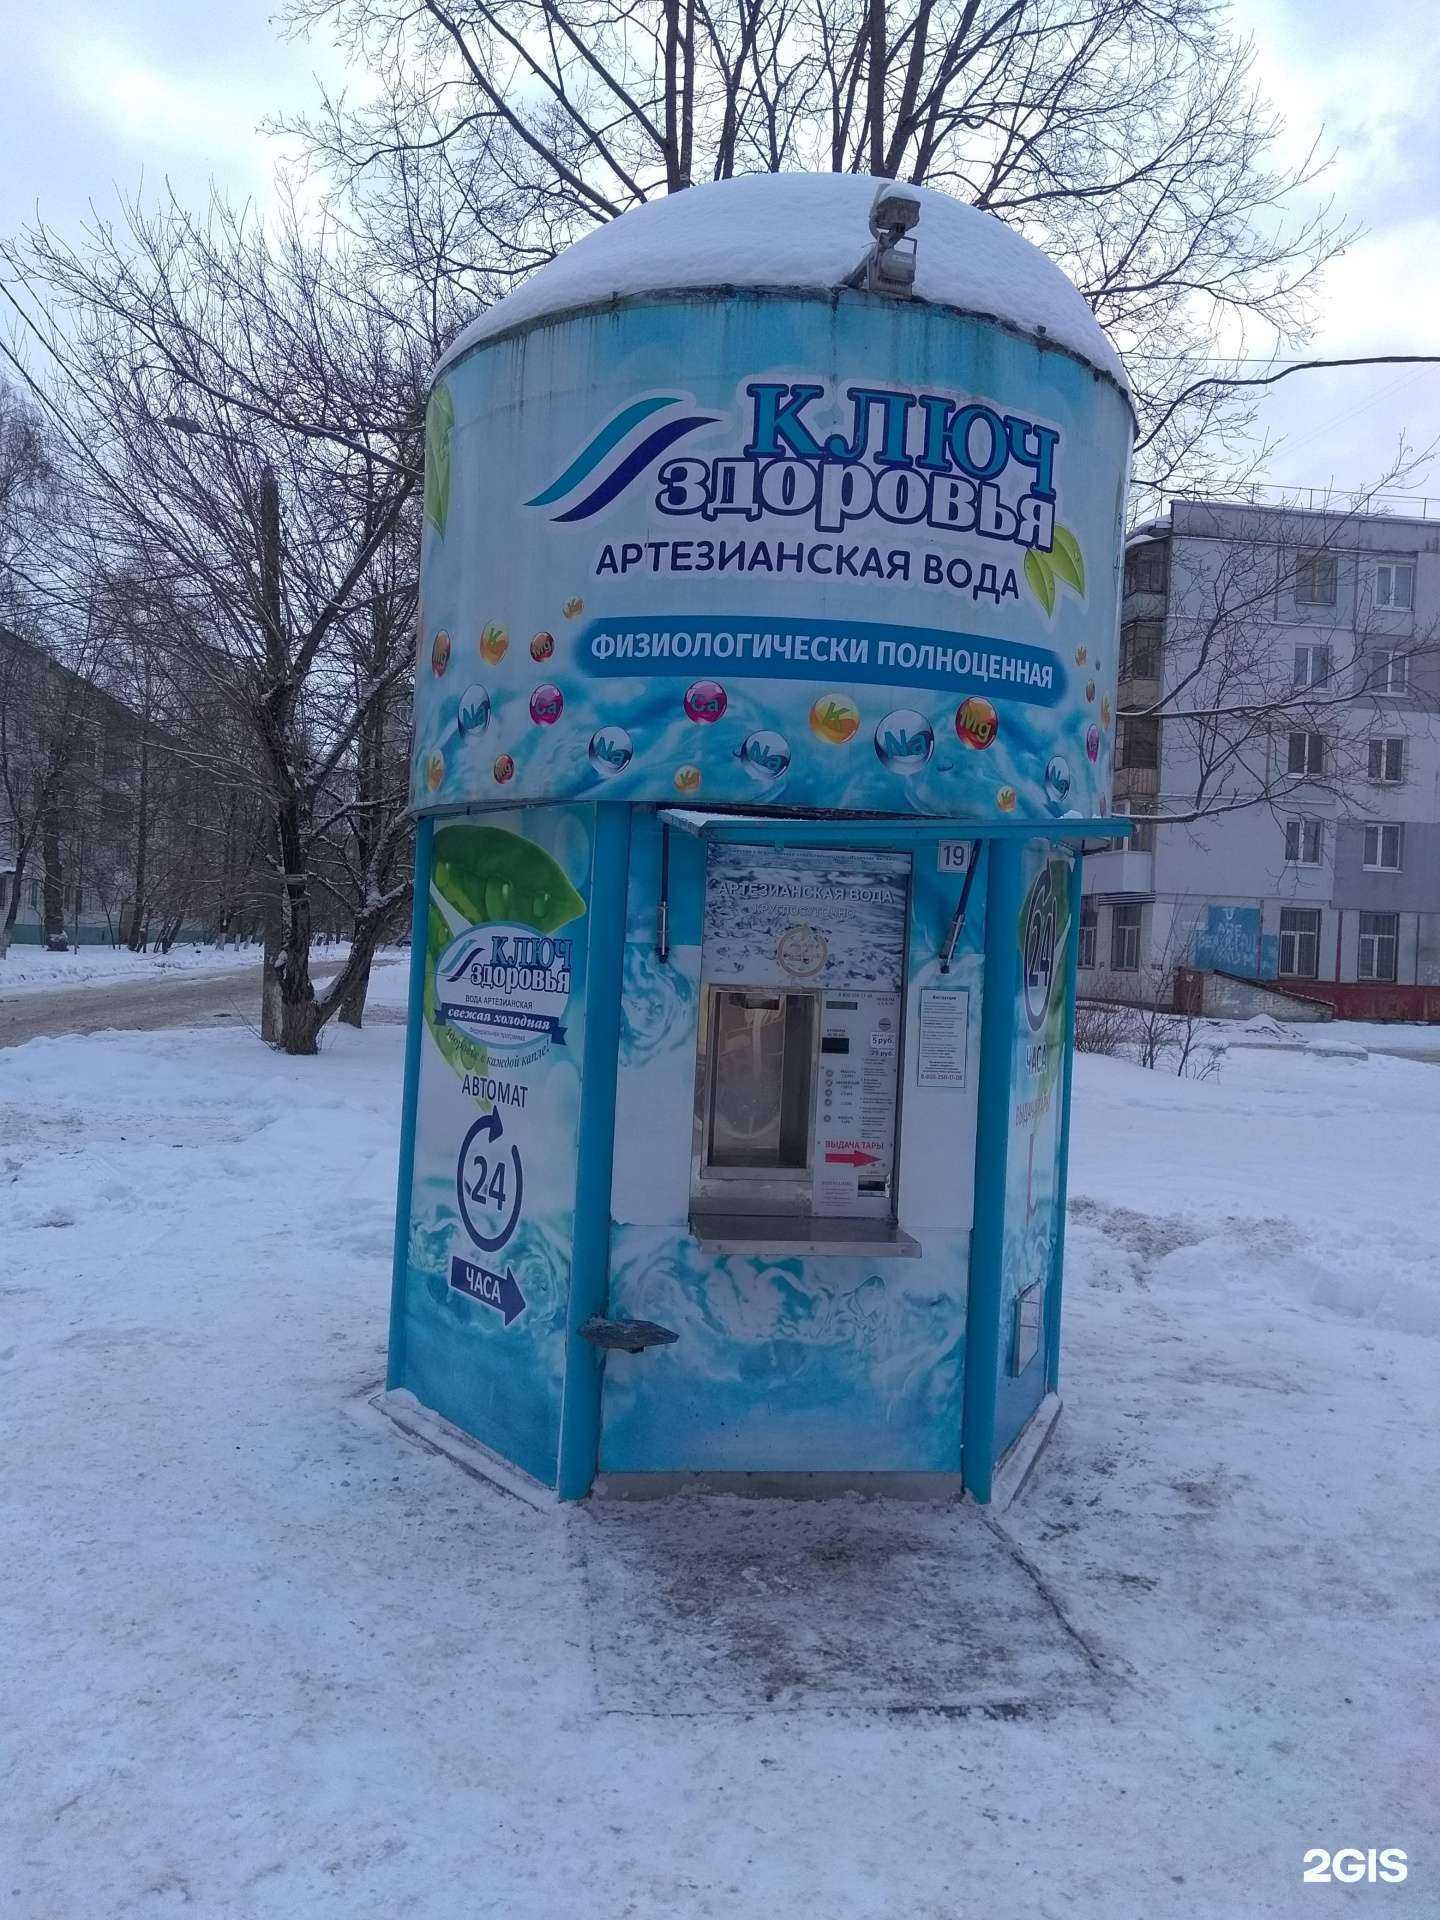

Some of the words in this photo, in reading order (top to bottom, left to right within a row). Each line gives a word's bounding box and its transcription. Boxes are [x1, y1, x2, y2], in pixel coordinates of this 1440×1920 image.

[744, 382, 1060, 499] КЛЮЧ
[595, 541, 910, 580] АРТЕЗИАНСКАЯ
[923, 554, 1019, 604] ВОДА
[591, 631, 868, 664] ФИЗИОЛОГИЧЕСКИ
[878, 640, 1053, 690] ПОЛНОЦЕННАЯ
[885, 730, 928, 758] Na
[943, 845, 965, 867] 19
[719, 881, 846, 902] АРТЕЗИАНСКАЯ
[848, 888, 896, 904] ВОДА
[489, 935, 573, 971] КЛЮЧ
[465, 994, 482, 1006] ВОДА
[484, 997, 534, 1011] АРТЕЗИАНСКАЯ
[447, 1007, 492, 1023] свежая
[494, 1013, 551, 1031] холодная
[487, 1053, 523, 1070] каждой
[522, 1040, 551, 1067] капле!
[461, 1073, 529, 1108] АВТОМАТ
[825, 1139, 859, 1150] ВЫДАЧА
[861, 1140, 884, 1151] ТАРЫ
[470, 1155, 507, 1213] 24
[466, 1261, 503, 1304] ЧАСА
